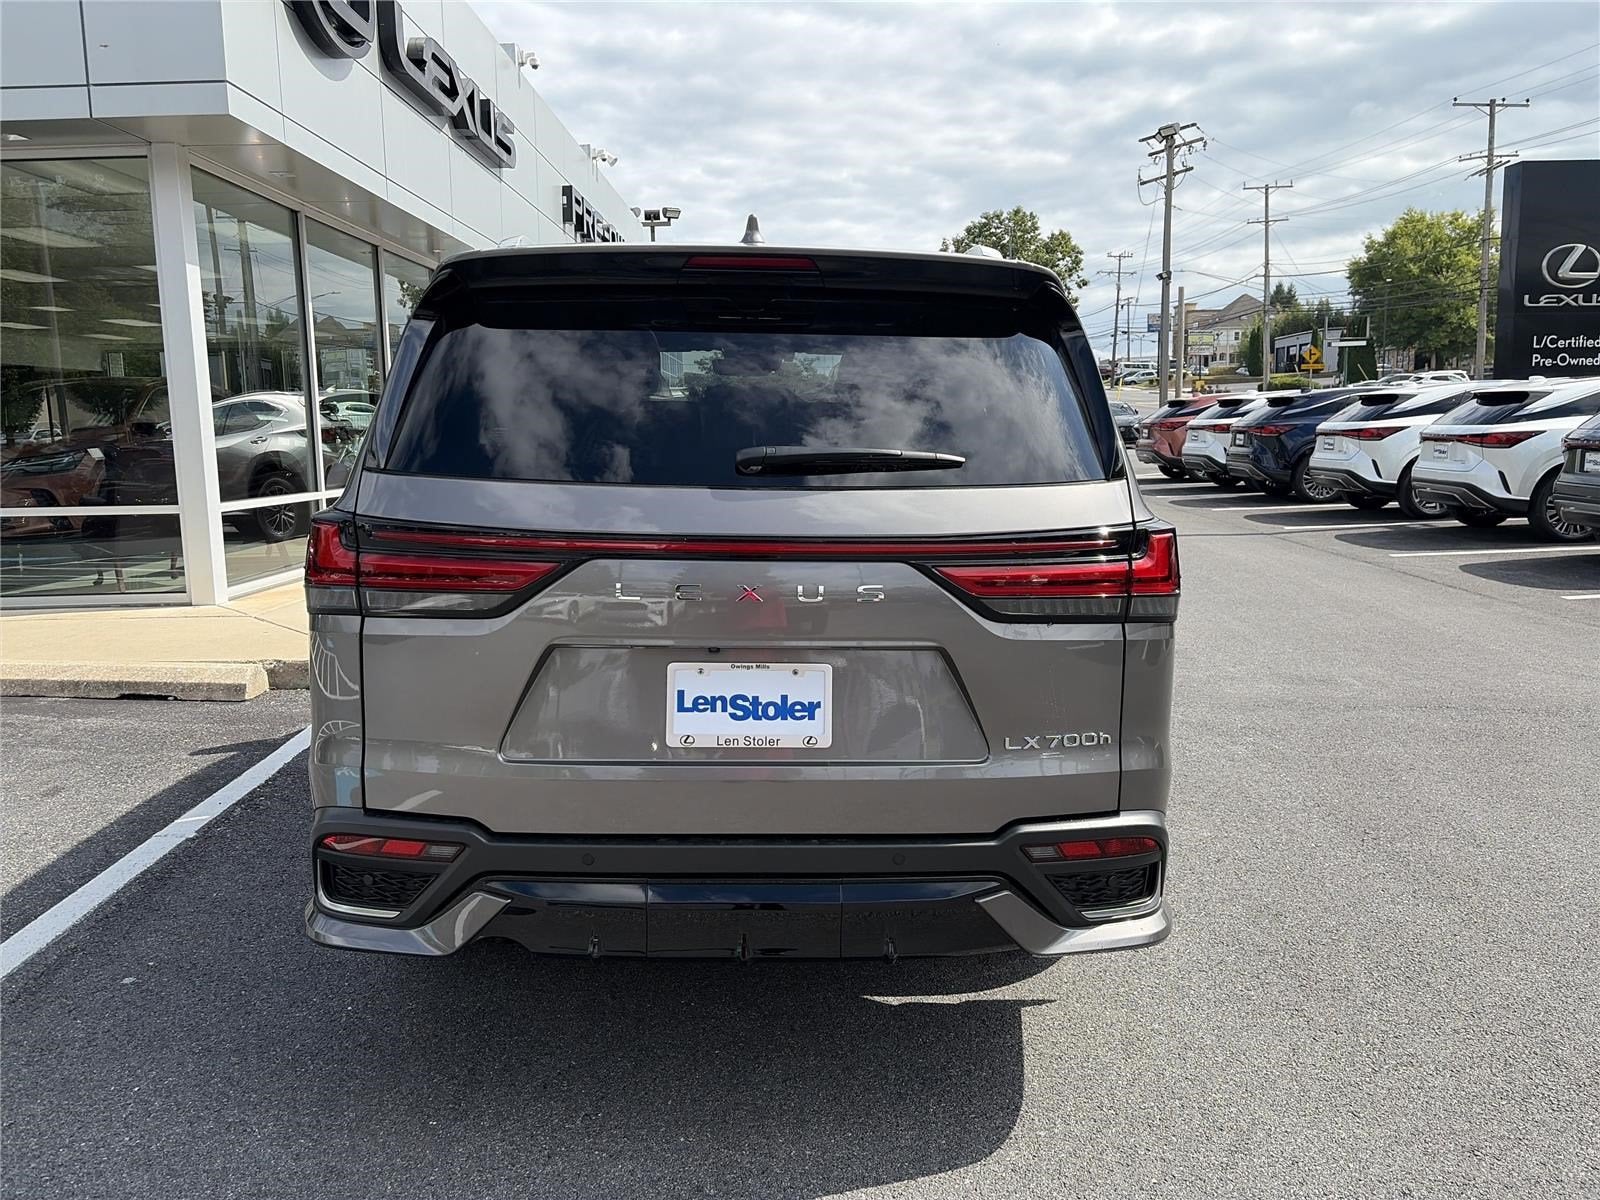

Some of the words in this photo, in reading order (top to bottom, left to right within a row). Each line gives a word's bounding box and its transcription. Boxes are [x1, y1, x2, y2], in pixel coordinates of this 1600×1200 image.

[376, 0, 516, 168] LEXUS
[1523, 293, 1600, 307] LEXU
[1533, 334, 1600, 349] L/Certified
[1531, 352, 1600, 367] Pre-Owned
[615, 582, 886, 603] LEXUS
[716, 735, 740, 747] Len
[743, 735, 782, 747] Stoler
[1004, 735, 1040, 750] LX
[1045, 731, 1112, 749] 700h
